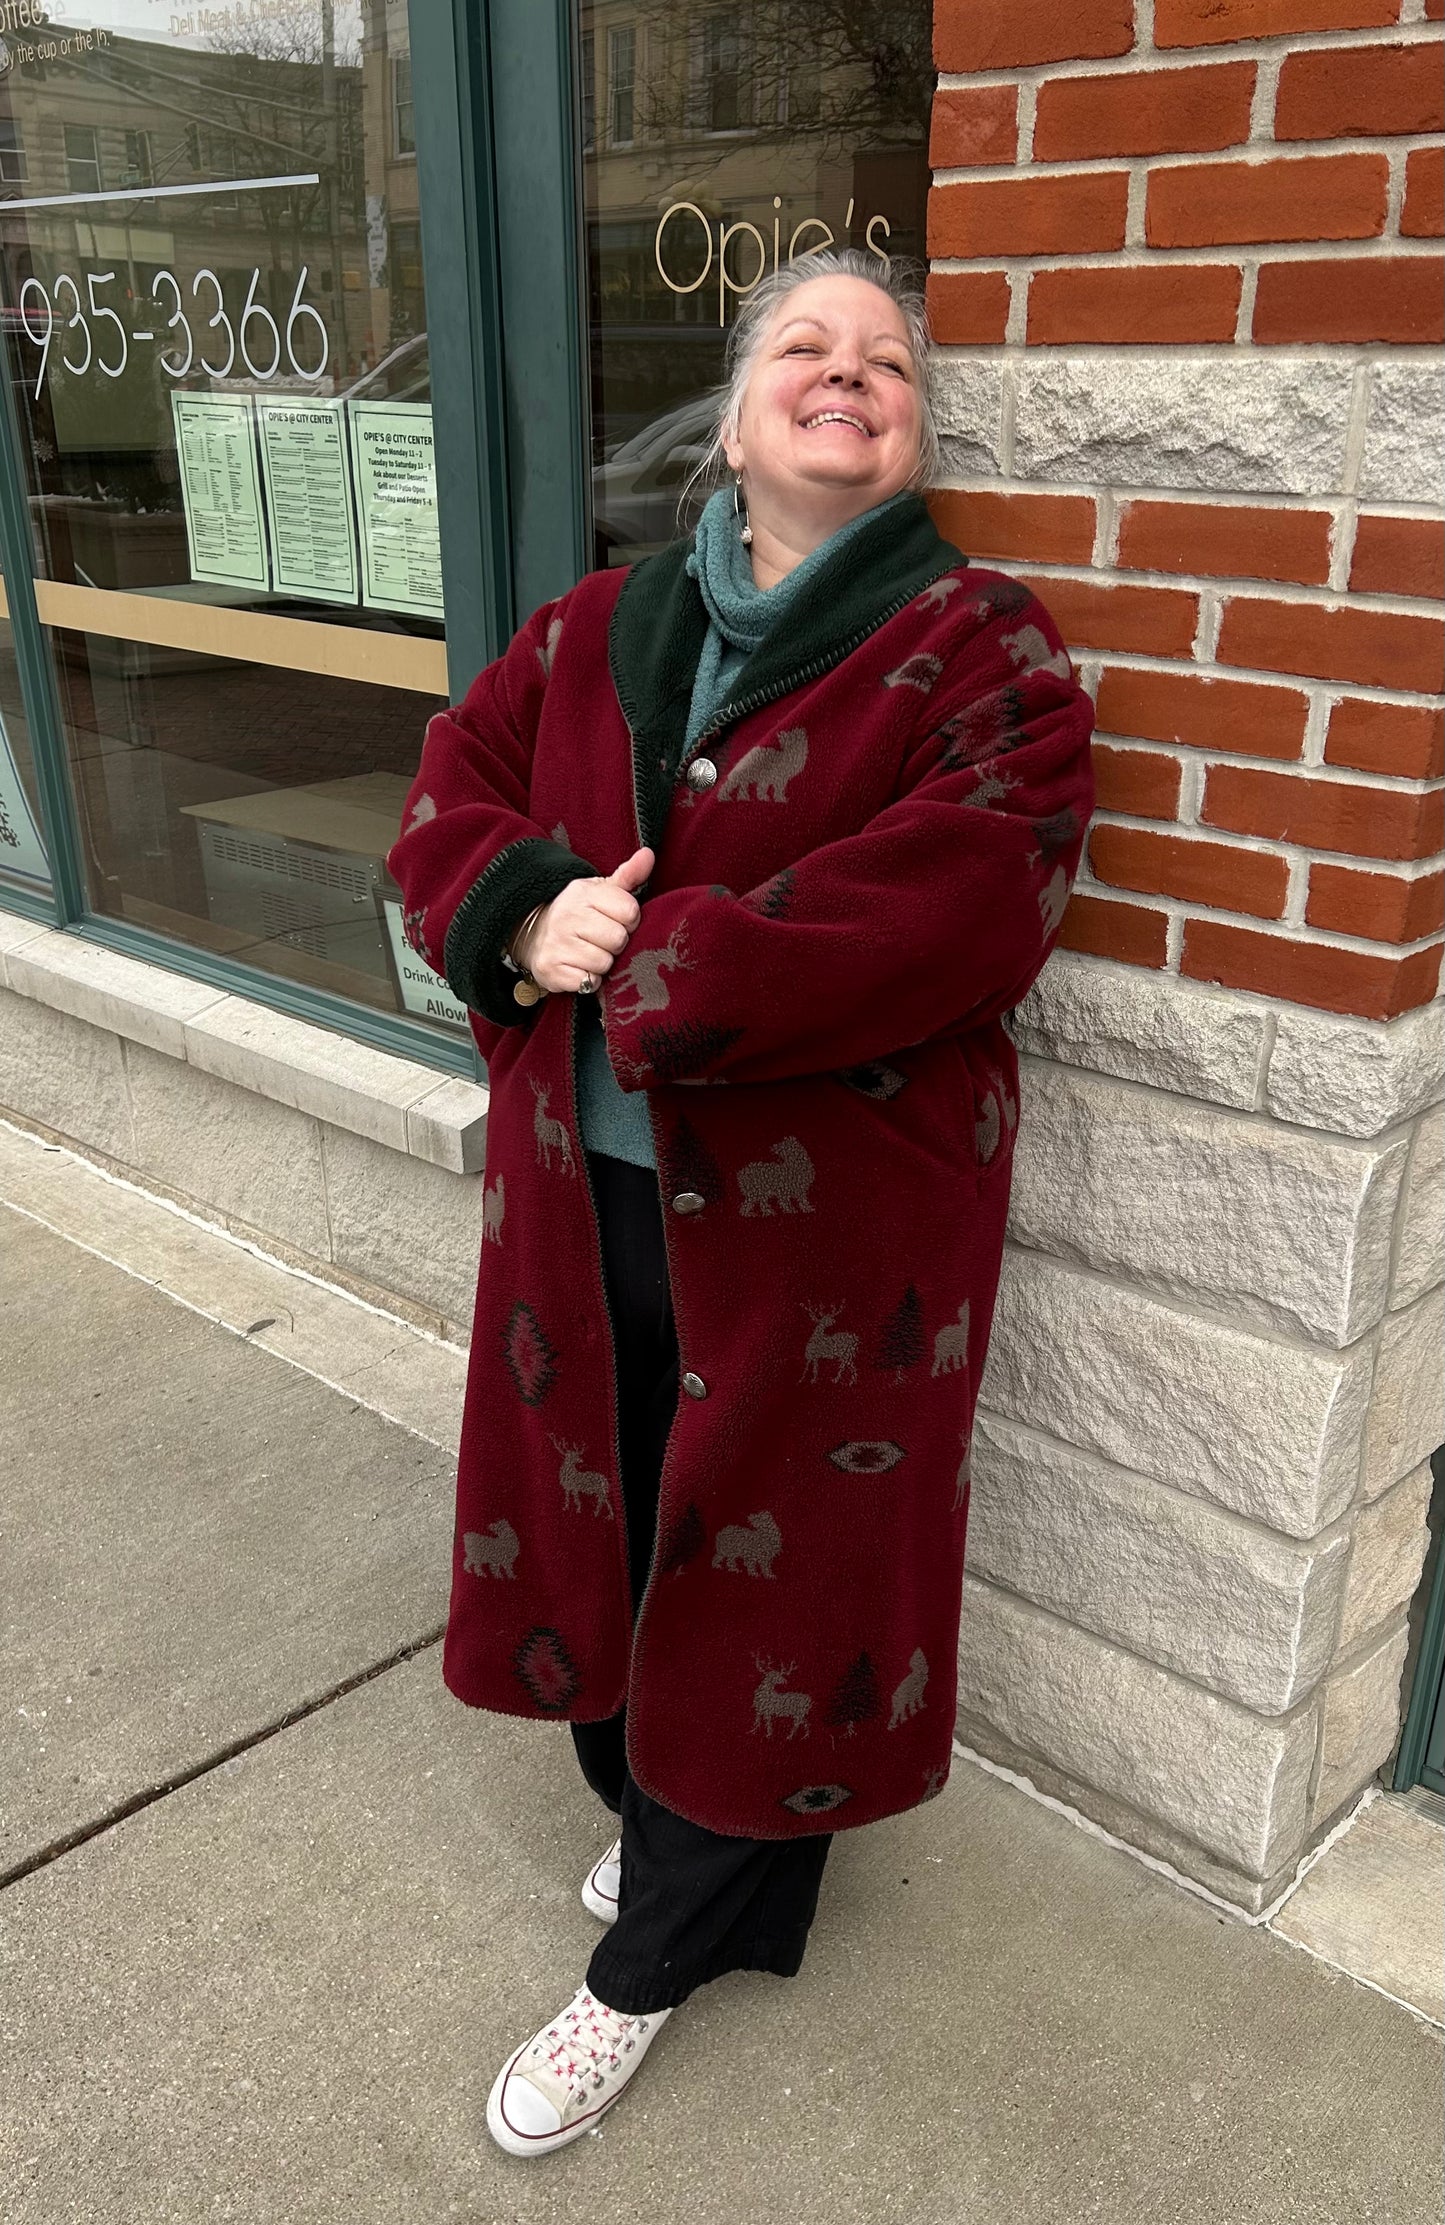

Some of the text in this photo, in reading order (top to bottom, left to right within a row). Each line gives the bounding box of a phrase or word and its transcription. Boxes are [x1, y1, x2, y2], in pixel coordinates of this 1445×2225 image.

[17, 43, 34, 63] the
[37, 41, 57, 62] cup
[60, 38, 71, 55] or
[75, 30, 94, 52] the
[655, 196, 891, 328] Opie's
[20, 265, 328, 401] 935-3366
[268, 412, 333, 425] OPIE'S @ CITY CENTER
[364, 432, 432, 446] OPIE'S @ CITY CENTER
[375, 447, 388, 455] Open
[389, 448, 408, 458] Monday
[368, 458, 388, 468] Tuesday
[395, 460, 417, 470] Saturday
[383, 471, 397, 479] about
[373, 492, 395, 503] Thursday
[407, 496, 422, 505] Friday
[403, 967, 434, 985] Drink
